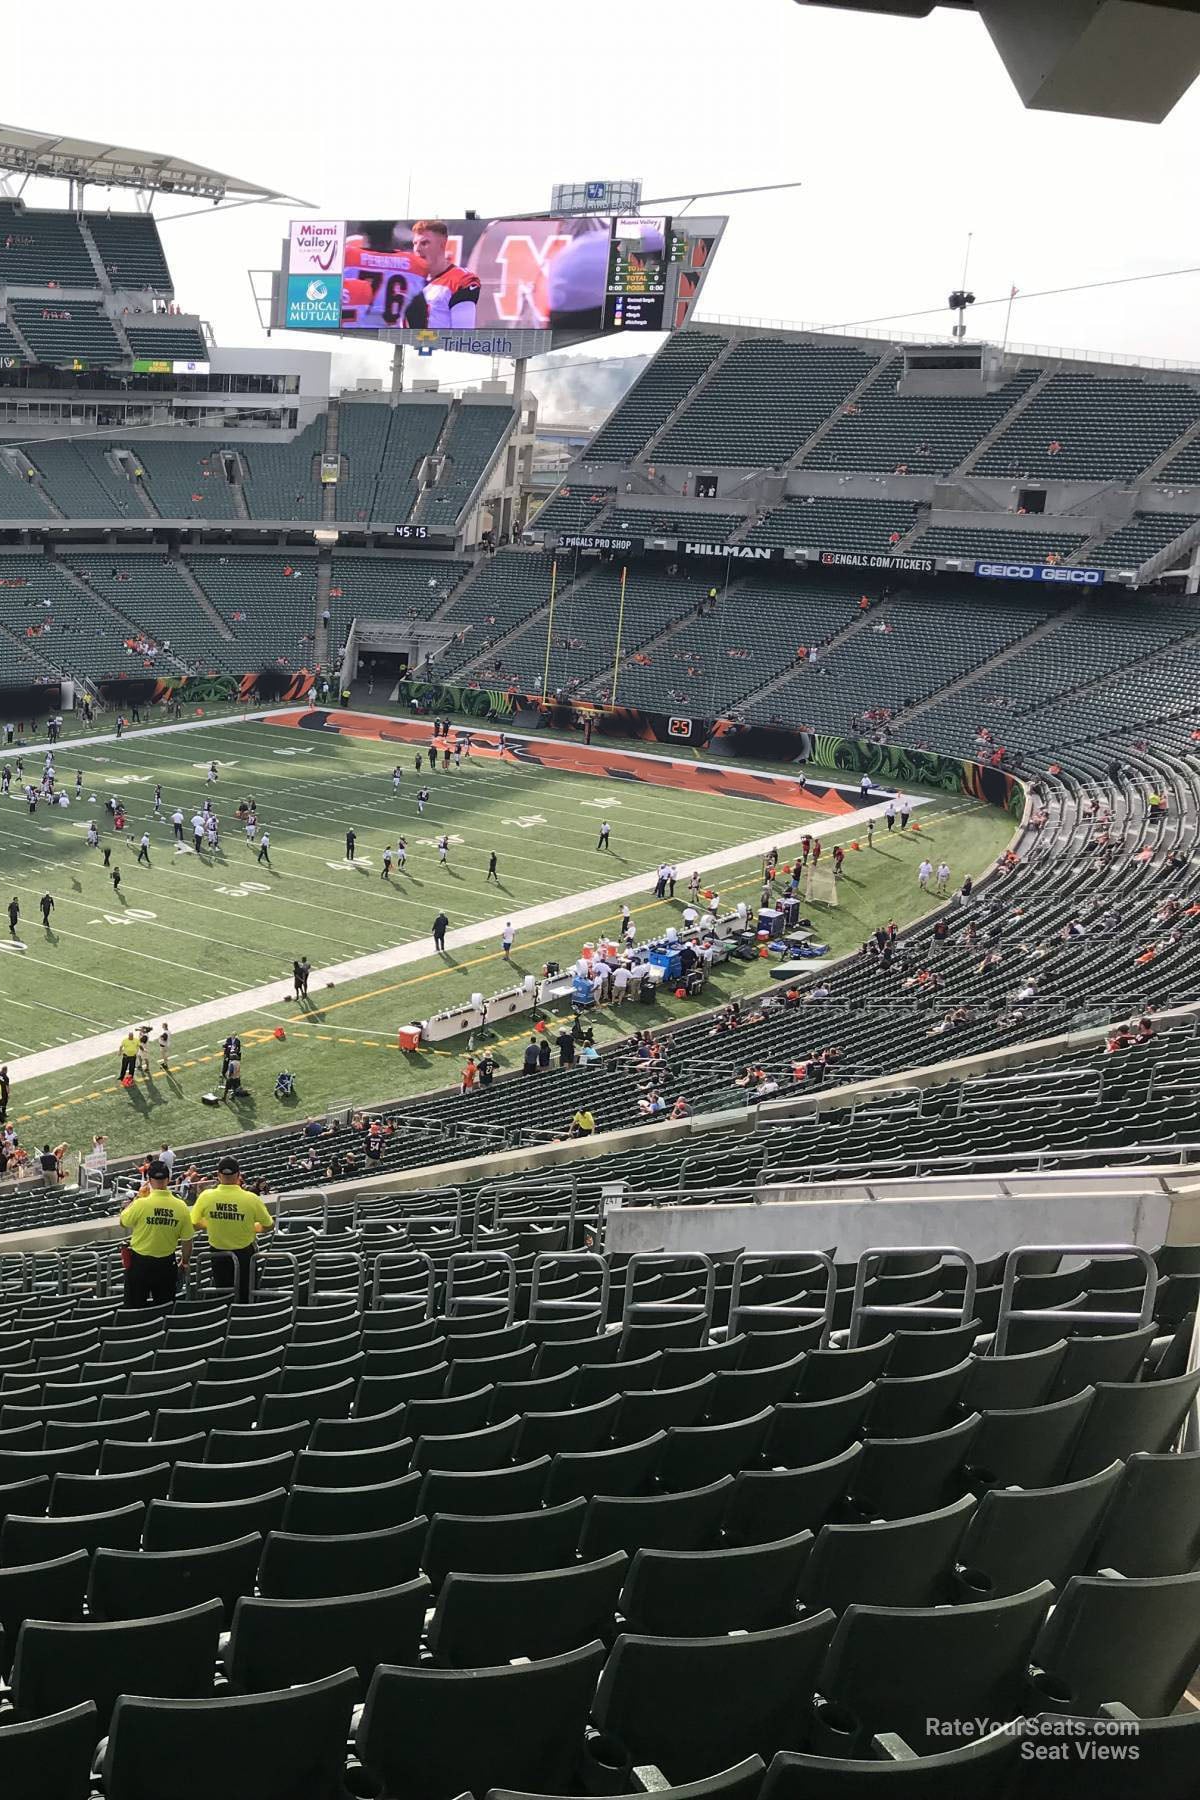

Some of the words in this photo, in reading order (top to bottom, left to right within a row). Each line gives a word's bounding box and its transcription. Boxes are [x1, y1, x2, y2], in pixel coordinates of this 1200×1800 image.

[300, 225, 337, 236] Miami
[297, 237, 332, 253] Valley
[356, 270, 409, 324] 76
[290, 302, 338, 311] MEDICAL
[290, 312, 338, 321] MUTUAL
[442, 336, 512, 353] TriHealth
[396, 526, 426, 538] 45:15
[595, 538, 610, 548] PRO
[611, 540, 632, 549] SHOP
[685, 543, 771, 559] HILLMAN
[978, 564, 1034, 578] GEICO
[1041, 568, 1099, 583] GEICO
[672, 720, 688, 734] 25
[370, 1141, 380, 1151] 54
[215, 1202, 238, 1212] WESS
[153, 1208, 174, 1218] WESS
[209, 1211, 245, 1222] SECURITY
[146, 1216, 179, 1227] SECURITY
